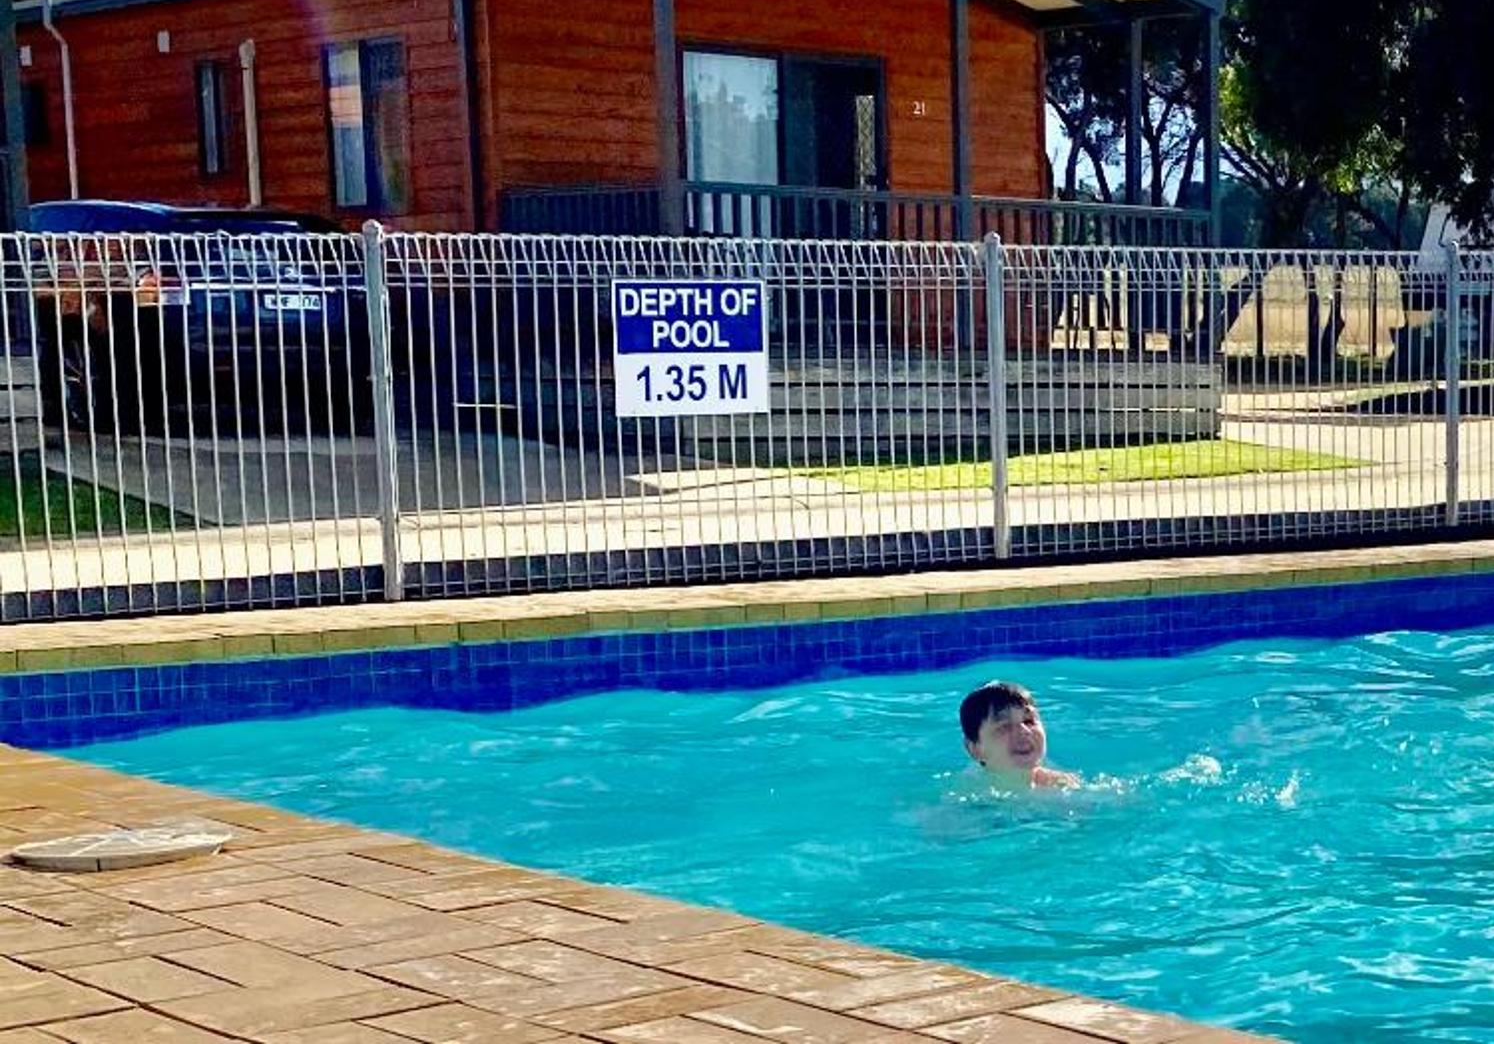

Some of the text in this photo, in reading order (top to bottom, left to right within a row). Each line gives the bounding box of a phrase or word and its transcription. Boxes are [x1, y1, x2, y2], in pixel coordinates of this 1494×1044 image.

[912, 100, 926, 116] 21
[619, 288, 757, 317] DEPTH OF
[653, 320, 730, 348] POOL
[637, 363, 748, 402] 1.35 M
